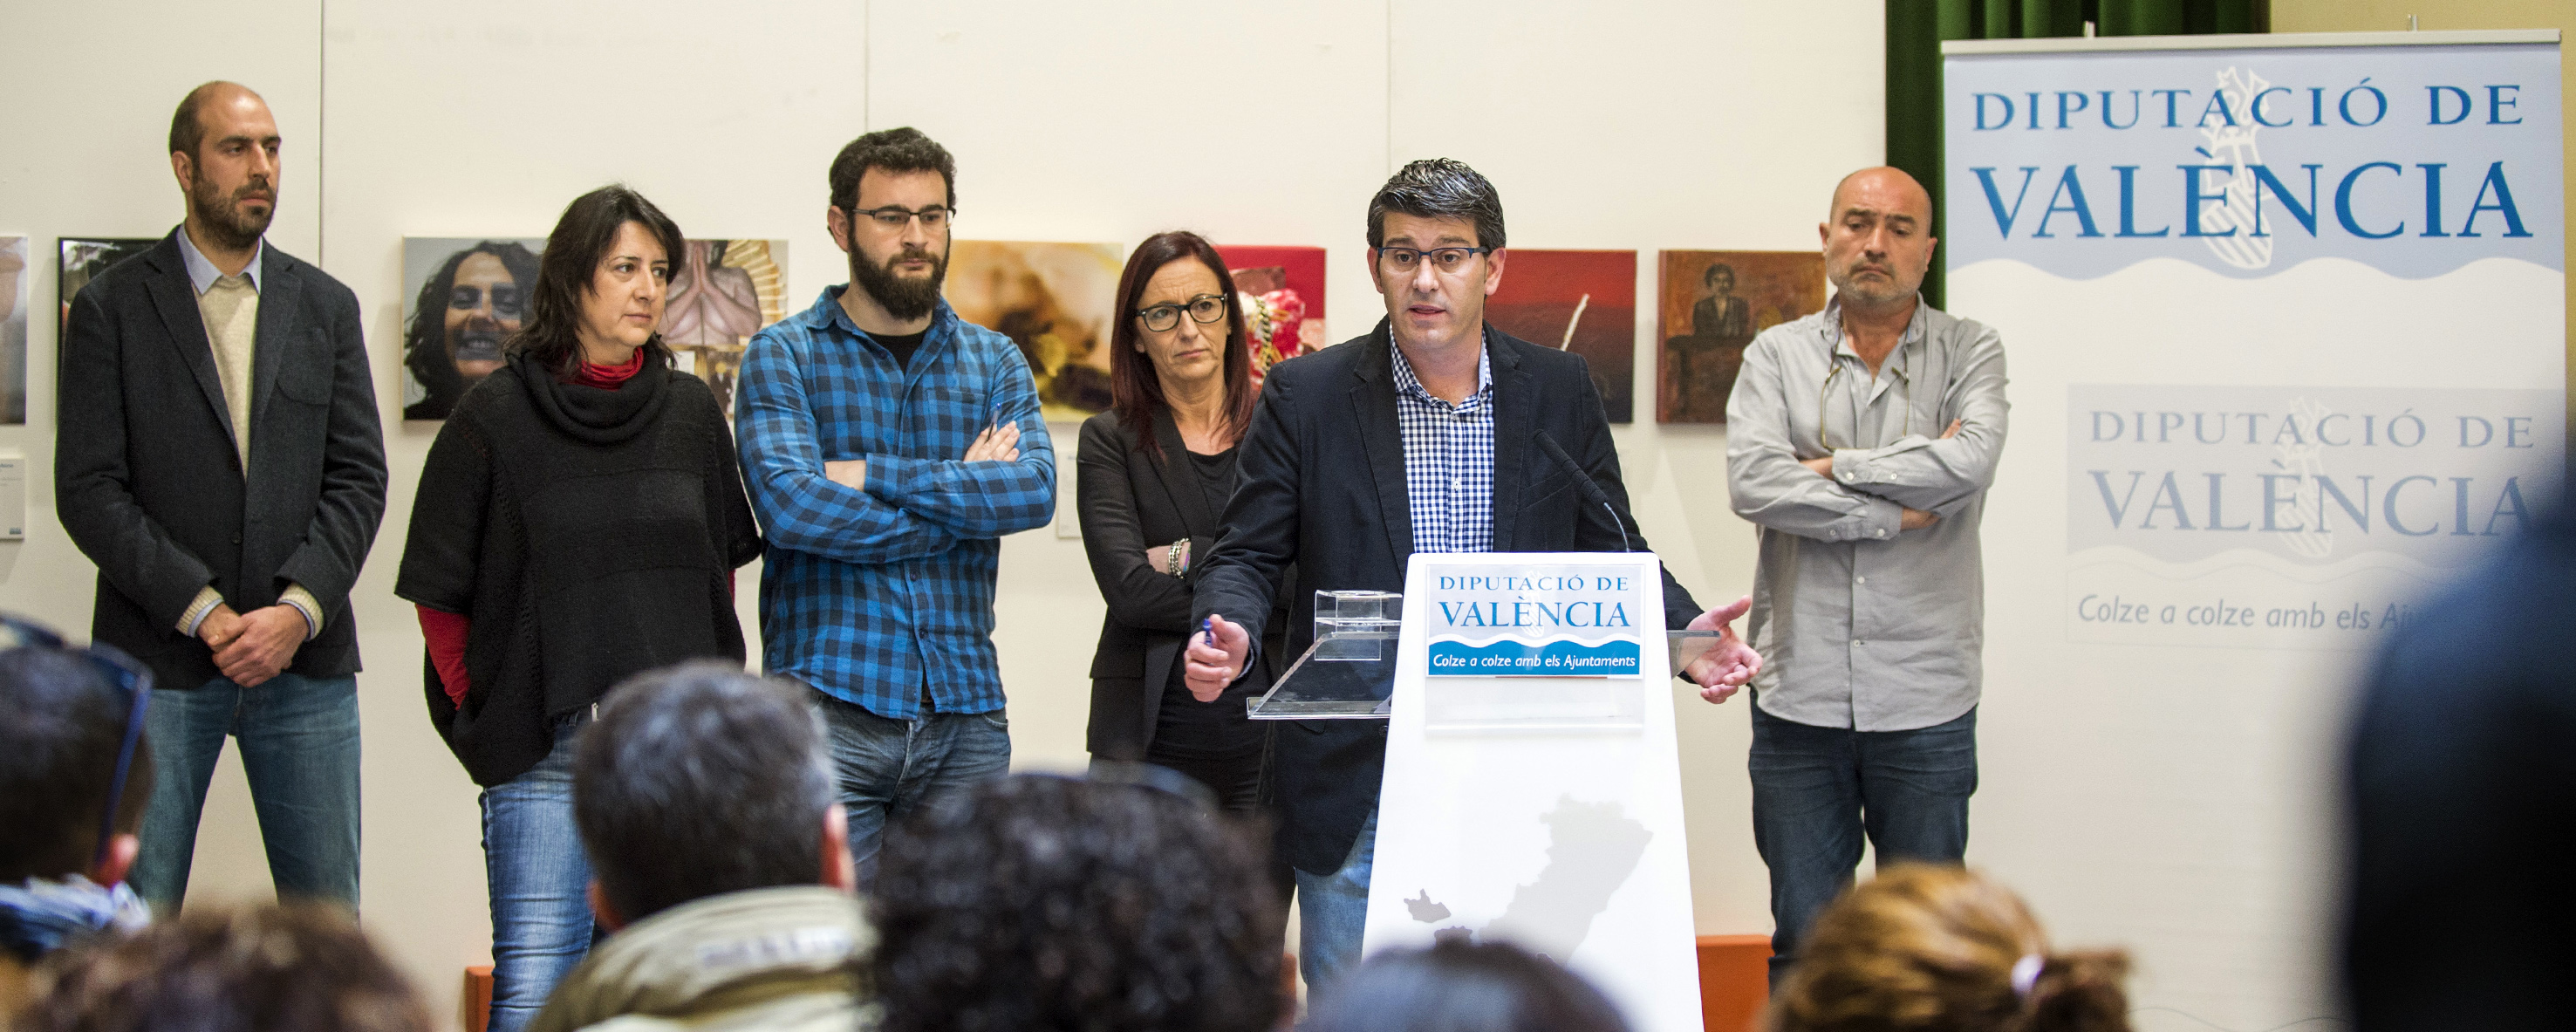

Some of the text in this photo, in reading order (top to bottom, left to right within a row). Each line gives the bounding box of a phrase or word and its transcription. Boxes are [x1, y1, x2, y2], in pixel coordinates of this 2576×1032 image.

[1972, 78, 2524, 131] DIPUTACIÓ DE
[1969, 147, 2534, 241] VALÈNCIA
[2089, 408, 2535, 448] DIPUTACIÓ DE
[1439, 574, 1629, 591] DIPUTACIÓ DE
[1438, 596, 1631, 627] VALÈNCIA
[2078, 595, 2149, 623] Colze
[2160, 603, 2176, 624] a
[2187, 599, 2256, 626] colze
[2267, 602, 2326, 629] amb
[2337, 604, 2371, 630] els
[1433, 654, 1636, 671] Colze a colze amb els Ajuntaments
